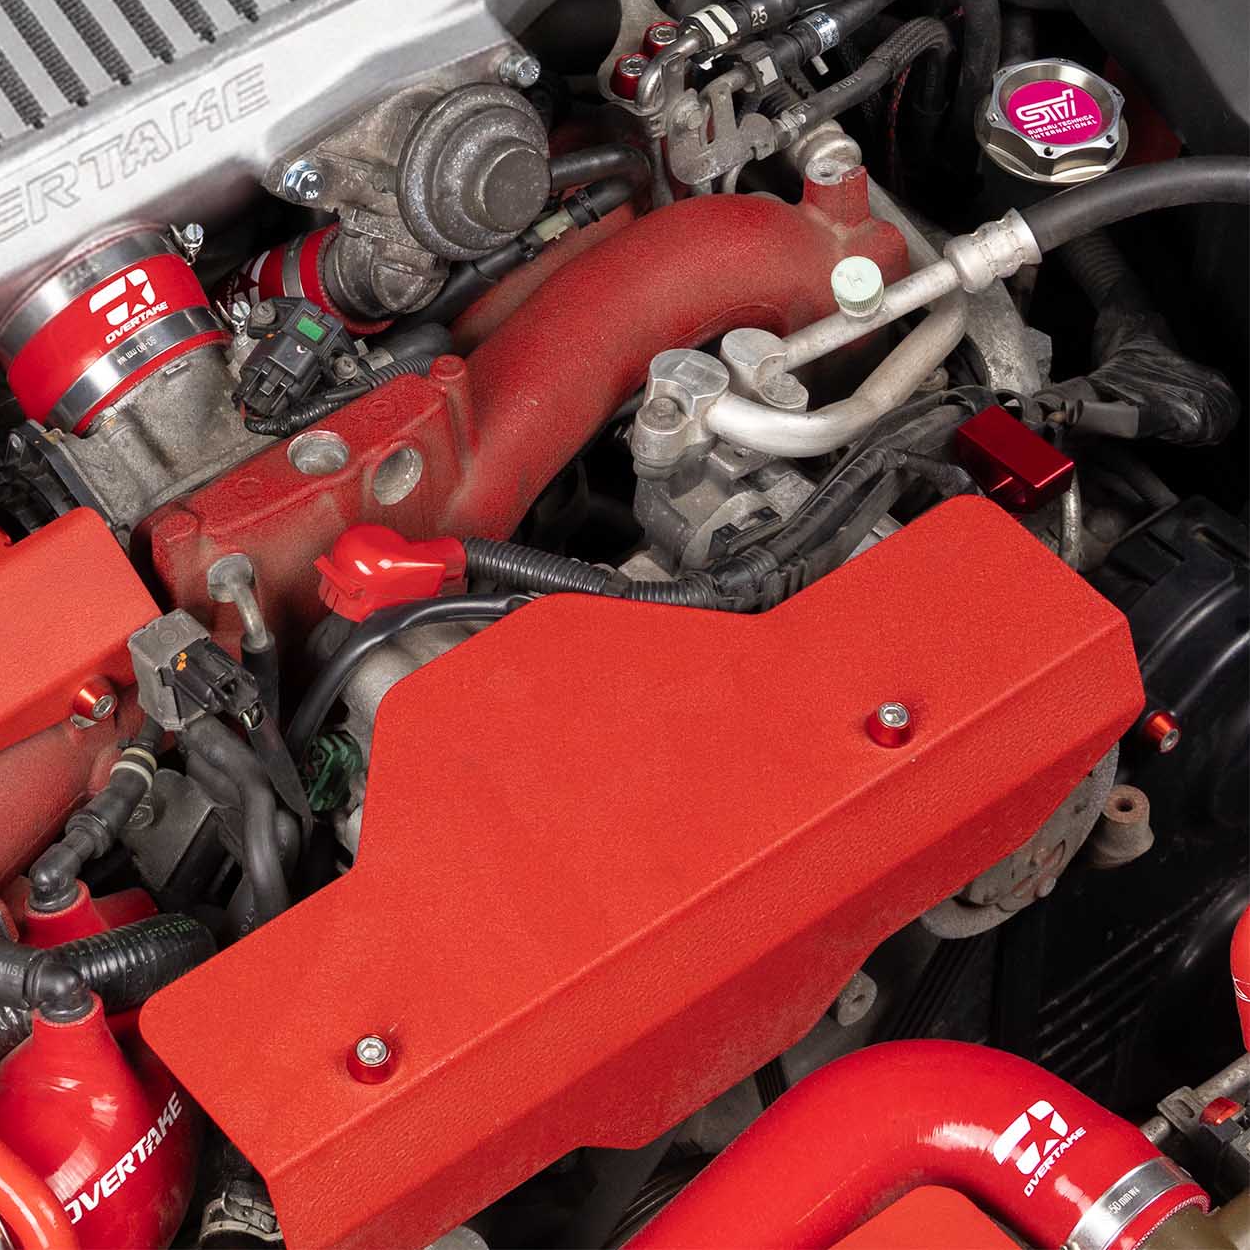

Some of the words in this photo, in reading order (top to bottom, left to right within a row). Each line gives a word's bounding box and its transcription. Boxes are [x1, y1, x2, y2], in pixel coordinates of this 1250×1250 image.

[1027, 123, 1058, 136] SUBARU
[1030, 119, 1098, 139] INTERNATIONAL
[105, 301, 169, 344] OVERTAKE
[1023, 1126, 1087, 1198] OVERTAKE
